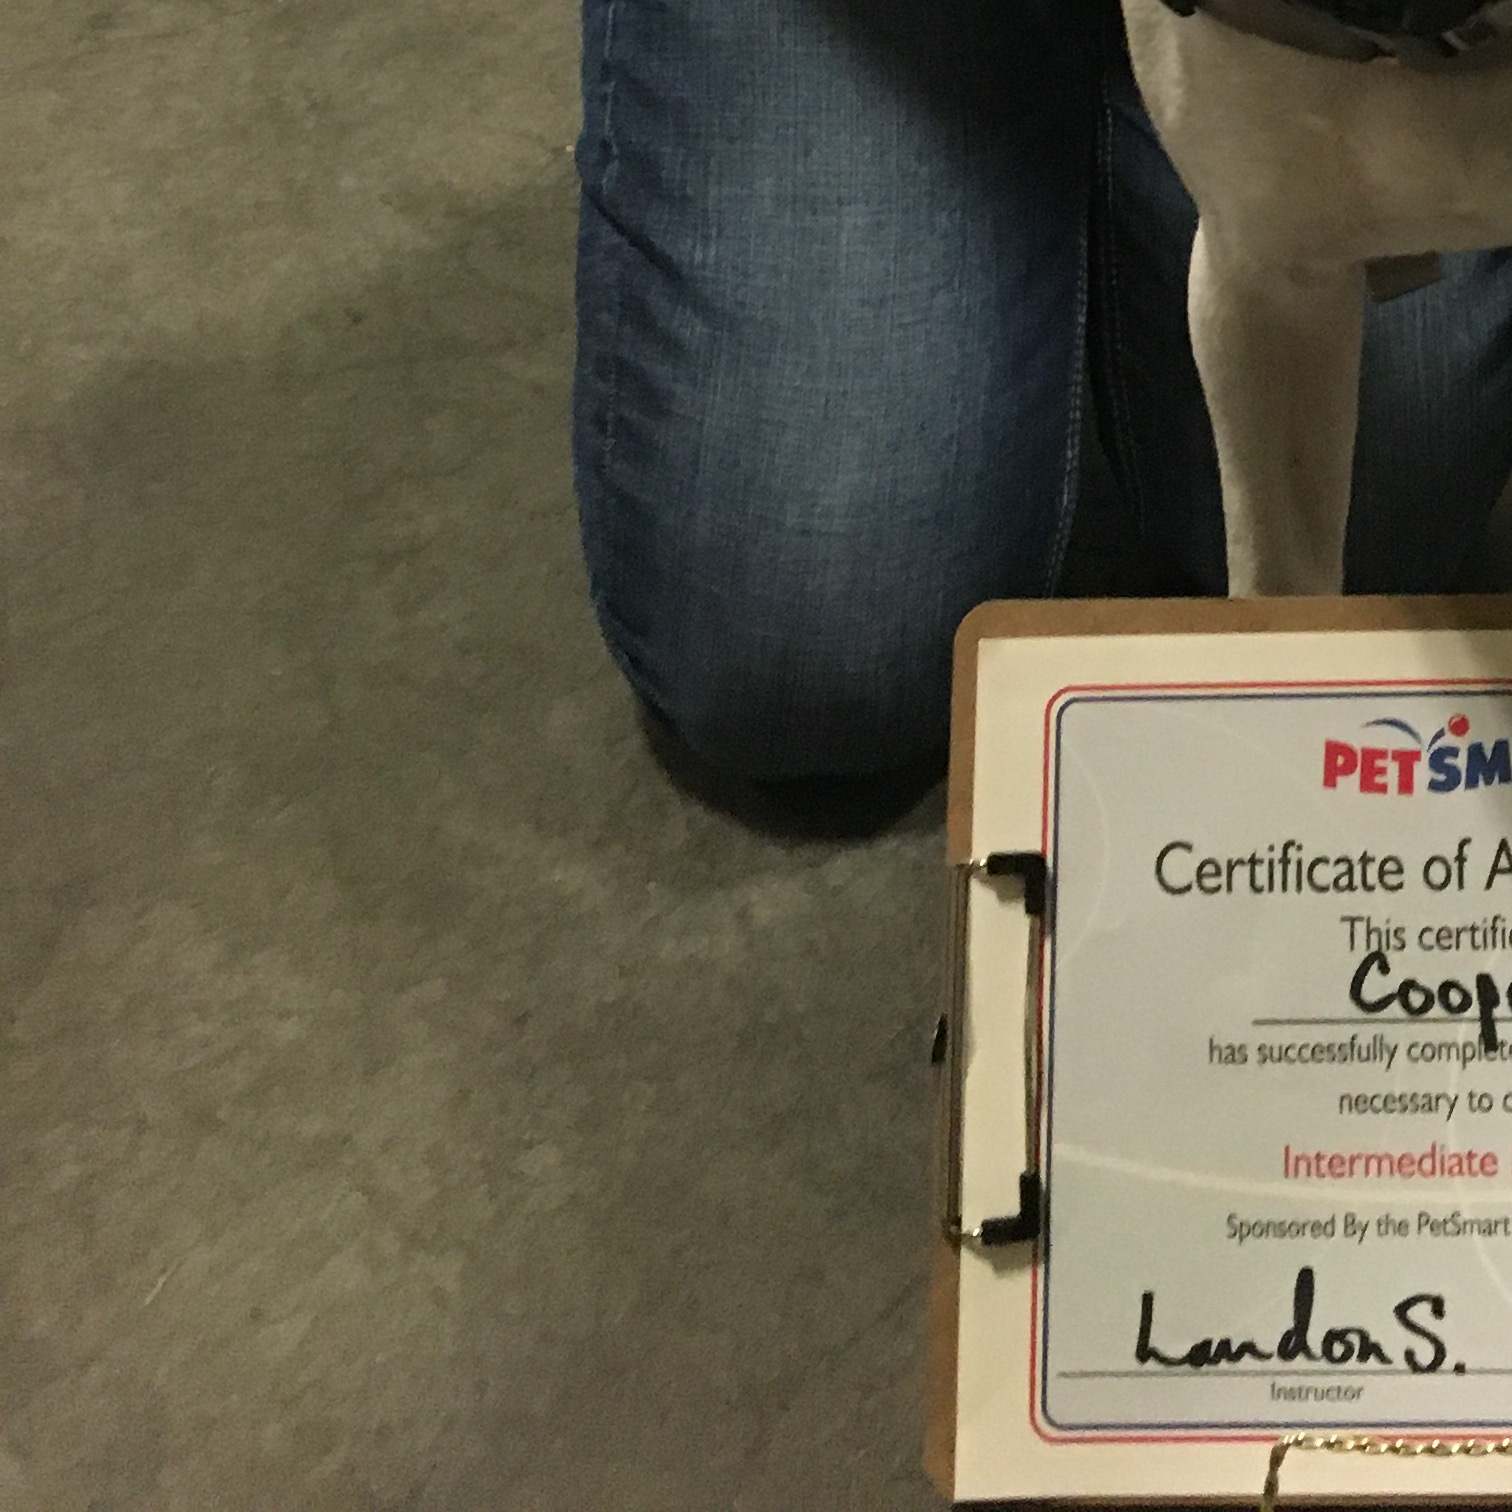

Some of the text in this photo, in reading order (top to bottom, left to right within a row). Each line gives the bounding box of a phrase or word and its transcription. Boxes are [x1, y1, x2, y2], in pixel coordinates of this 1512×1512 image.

[1155, 840, 1404, 895] Certificate
[1423, 838, 1471, 891] of
[1340, 915, 1406, 951] This
[1209, 1036, 1248, 1065] has
[1258, 1034, 1398, 1072] successfully
[1339, 1092, 1458, 1121] necessary
[1468, 1090, 1493, 1114] to
[1284, 1143, 1497, 1178] Intermediate
[1227, 1213, 1335, 1244] Sponsored
[1344, 1213, 1369, 1244] By
[1376, 1213, 1409, 1237] the
[1418, 1211, 1510, 1238] PetSmart
[1270, 1382, 1364, 1402] Instructor
